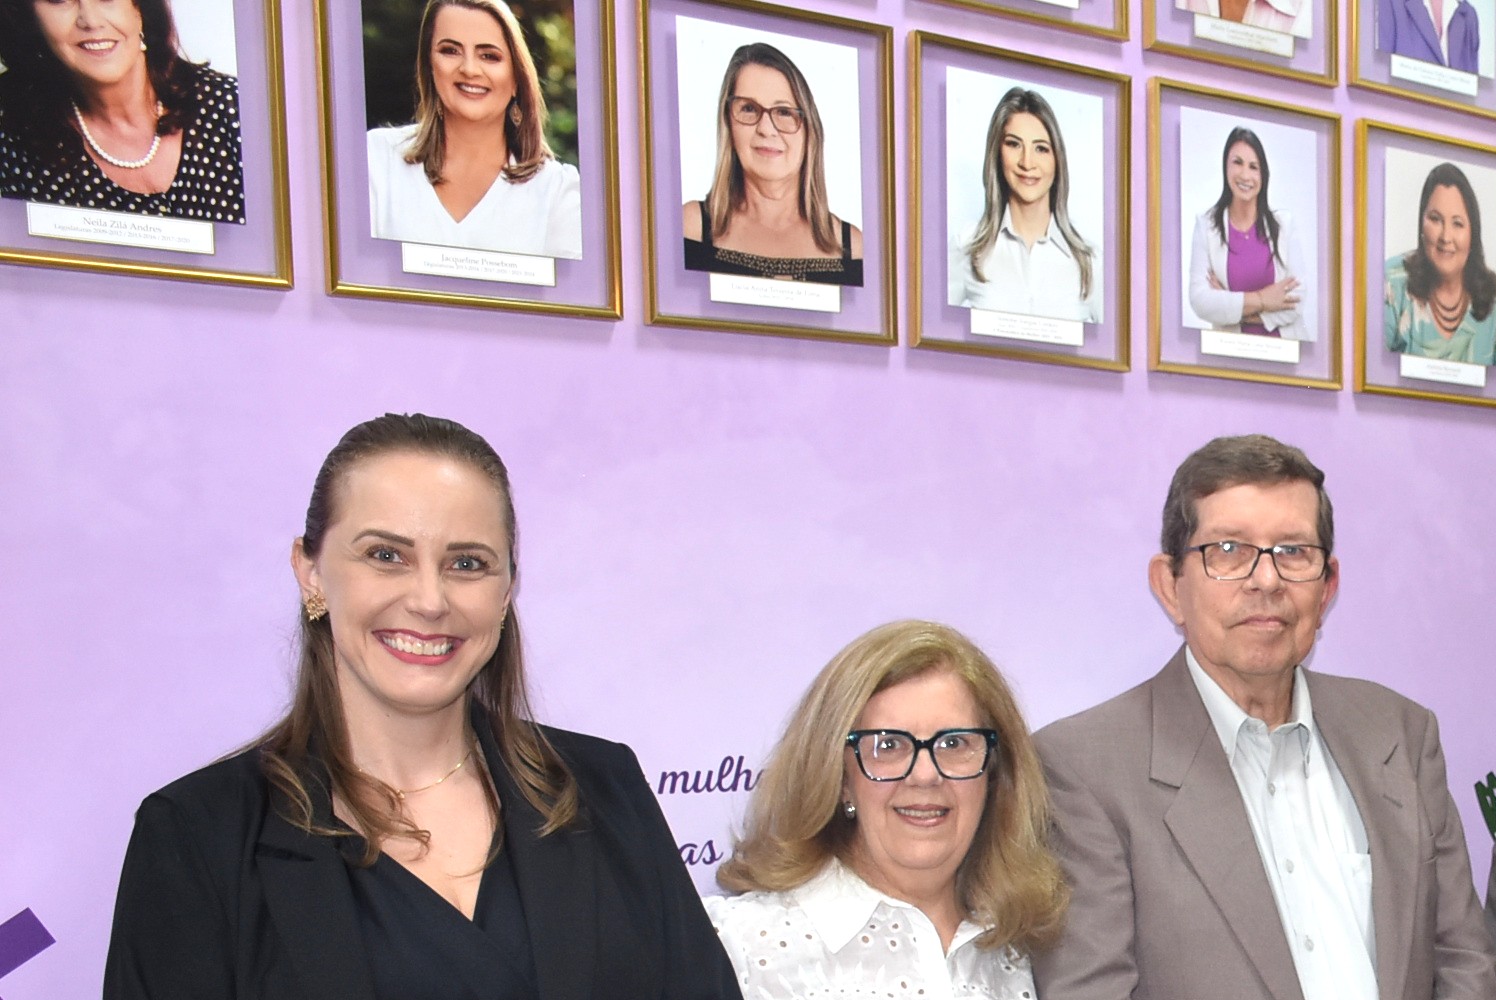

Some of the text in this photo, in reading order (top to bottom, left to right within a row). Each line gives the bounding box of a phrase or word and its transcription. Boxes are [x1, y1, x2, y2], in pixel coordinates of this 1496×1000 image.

[82, 216, 162, 233] Neila Zilá Andres
[442, 254, 480, 266] Jacqueline
[658, 755, 764, 794] mulh
